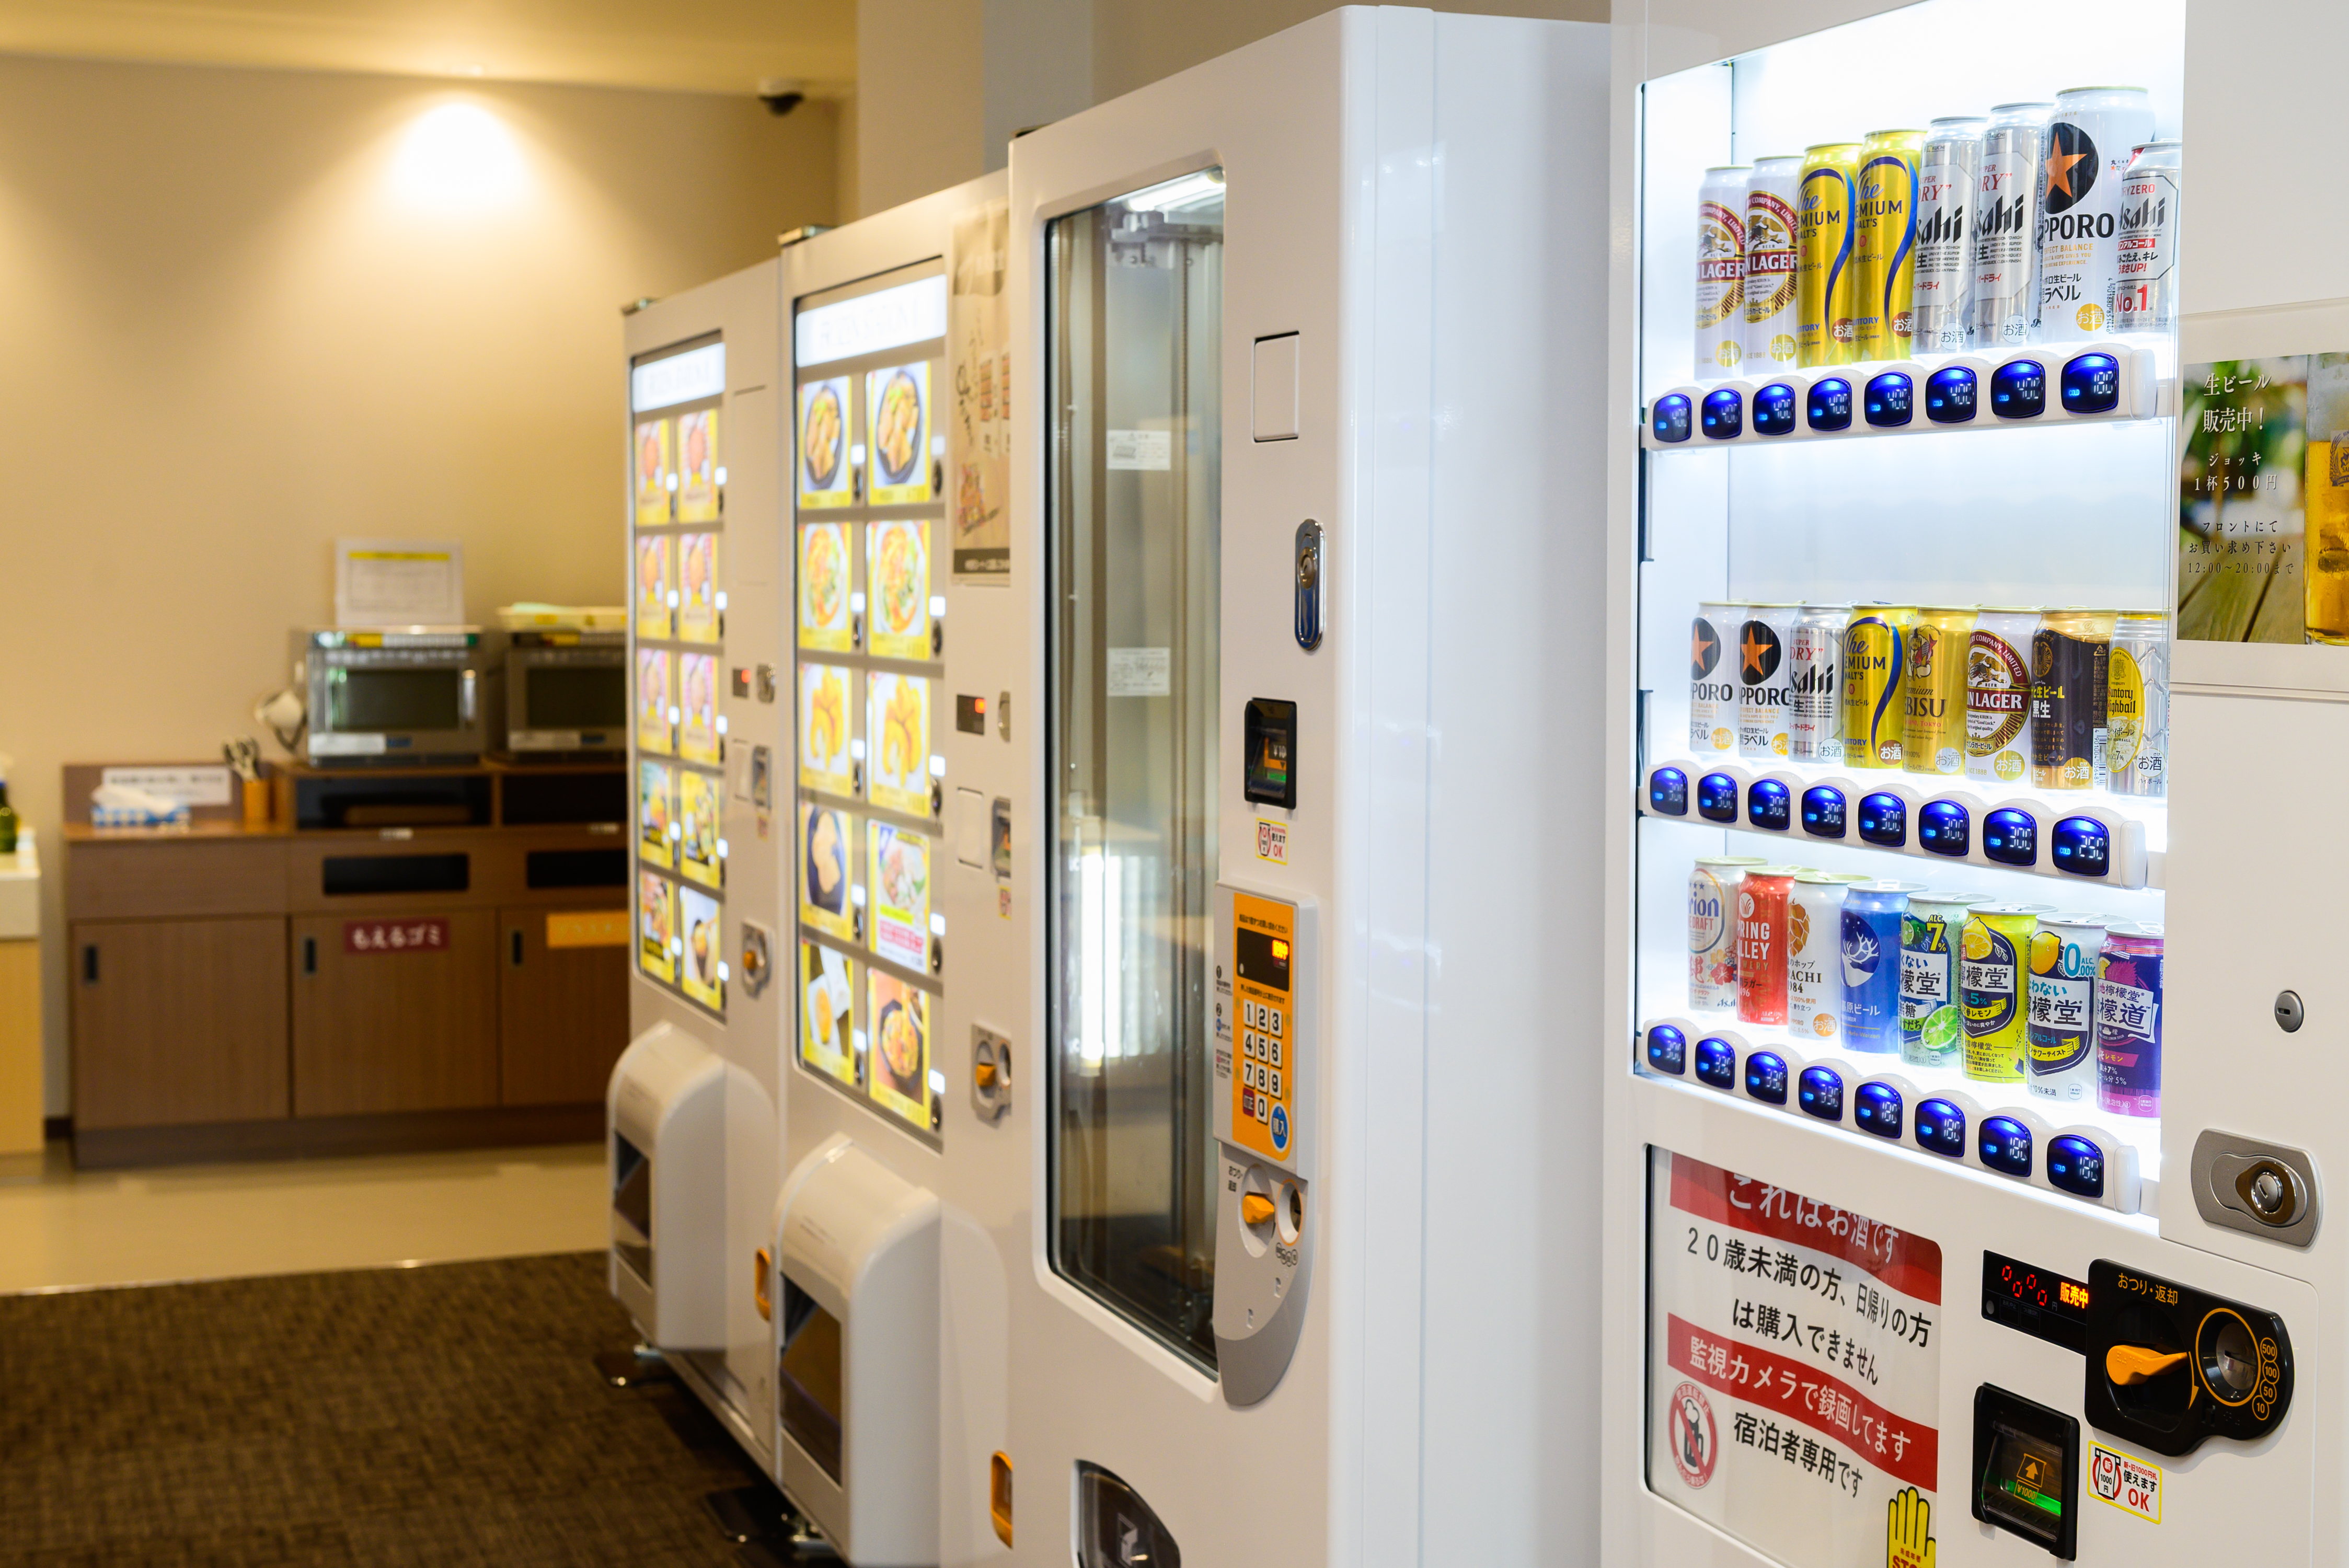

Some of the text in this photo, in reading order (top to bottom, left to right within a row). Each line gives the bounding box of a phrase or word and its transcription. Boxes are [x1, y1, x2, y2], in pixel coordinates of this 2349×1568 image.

[1752, 197, 1781, 212] COMPANY,
[1978, 244, 1989, 260] 生
[2060, 244, 2093, 252] BALANCE
[1753, 255, 1797, 271] LAGER
[1917, 252, 1927, 268] 生
[1702, 262, 1745, 279] LAGER
[1894, 318, 1913, 331] お酒
[2077, 310, 2103, 324] お酒
[1834, 325, 1852, 338] お酒
[1941, 331, 1964, 343] お酒
[2003, 324, 2028, 336] お酒
[1717, 348, 1739, 360] お酒
[1771, 342, 1793, 354] お酒
[2204, 372, 2272, 396] 生ビール
[2208, 452, 2262, 466] ジョッキ
[2194, 474, 2278, 491] 1杯500円
[2202, 520, 2278, 533] フロントにて
[2188, 540, 2292, 555] お買い求め下さい
[1976, 635, 2022, 677] COMPANY, LIMITED
[1976, 691, 2022, 709] LAGER
[2108, 686, 2133, 701] Suntory
[1794, 699, 1804, 712] 生
[2033, 700, 2051, 718] 黒生
[2108, 699, 2136, 716] Highball
[1713, 733, 1732, 745] お酒
[1821, 746, 1841, 757] お酒
[1880, 747, 1902, 760] お酒
[1936, 754, 1960, 767] お酒
[1996, 759, 2022, 772] お酒
[2138, 756, 2162, 771] お酒
[2065, 766, 2090, 779] お酒
[1273, 844, 1284, 858] OK
[1692, 917, 1714, 930] DRAFT
[1971, 993, 1987, 1005] 5%
[1247, 1004, 1250, 1022] 1
[1259, 1008, 1265, 1027] 2
[1272, 1012, 1279, 1031] 3
[1814, 1019, 1836, 1032] お酒
[1246, 1034, 1252, 1052] 4
[1259, 1037, 1265, 1057] 5
[1272, 1043, 1279, 1062] 6
[1246, 1063, 1252, 1081] 7
[1259, 1069, 1265, 1087] 8
[1272, 1074, 1279, 1092] 9
[2115, 1076, 2127, 1086] 5%
[1258, 1098, 1265, 1117] 0
[1729, 1172, 1899, 1264] これはお酒です
[2060, 1282, 2089, 1309] 販売中
[2117, 1273, 2179, 1306] おつり・返却
[1732, 1298, 1879, 1386] は購入できません
[2262, 1344, 2276, 1357] 500
[2264, 1365, 2277, 1378] 100
[1689, 1335, 1912, 1463] 監視カメラで録画してます
[2263, 1387, 2273, 1397] 50
[2256, 1402, 2265, 1413] 10
[1734, 1411, 1863, 1498] 宿泊者専用です
[2104, 1459, 2112, 1471] 新
[2100, 1473, 2112, 1485] 1000
[2124, 1469, 2157, 1493] 使えます
[2017, 1484, 2037, 1502] ¥1000
[2103, 1485, 2109, 1493] 円
[2128, 1488, 2150, 1513] OK
